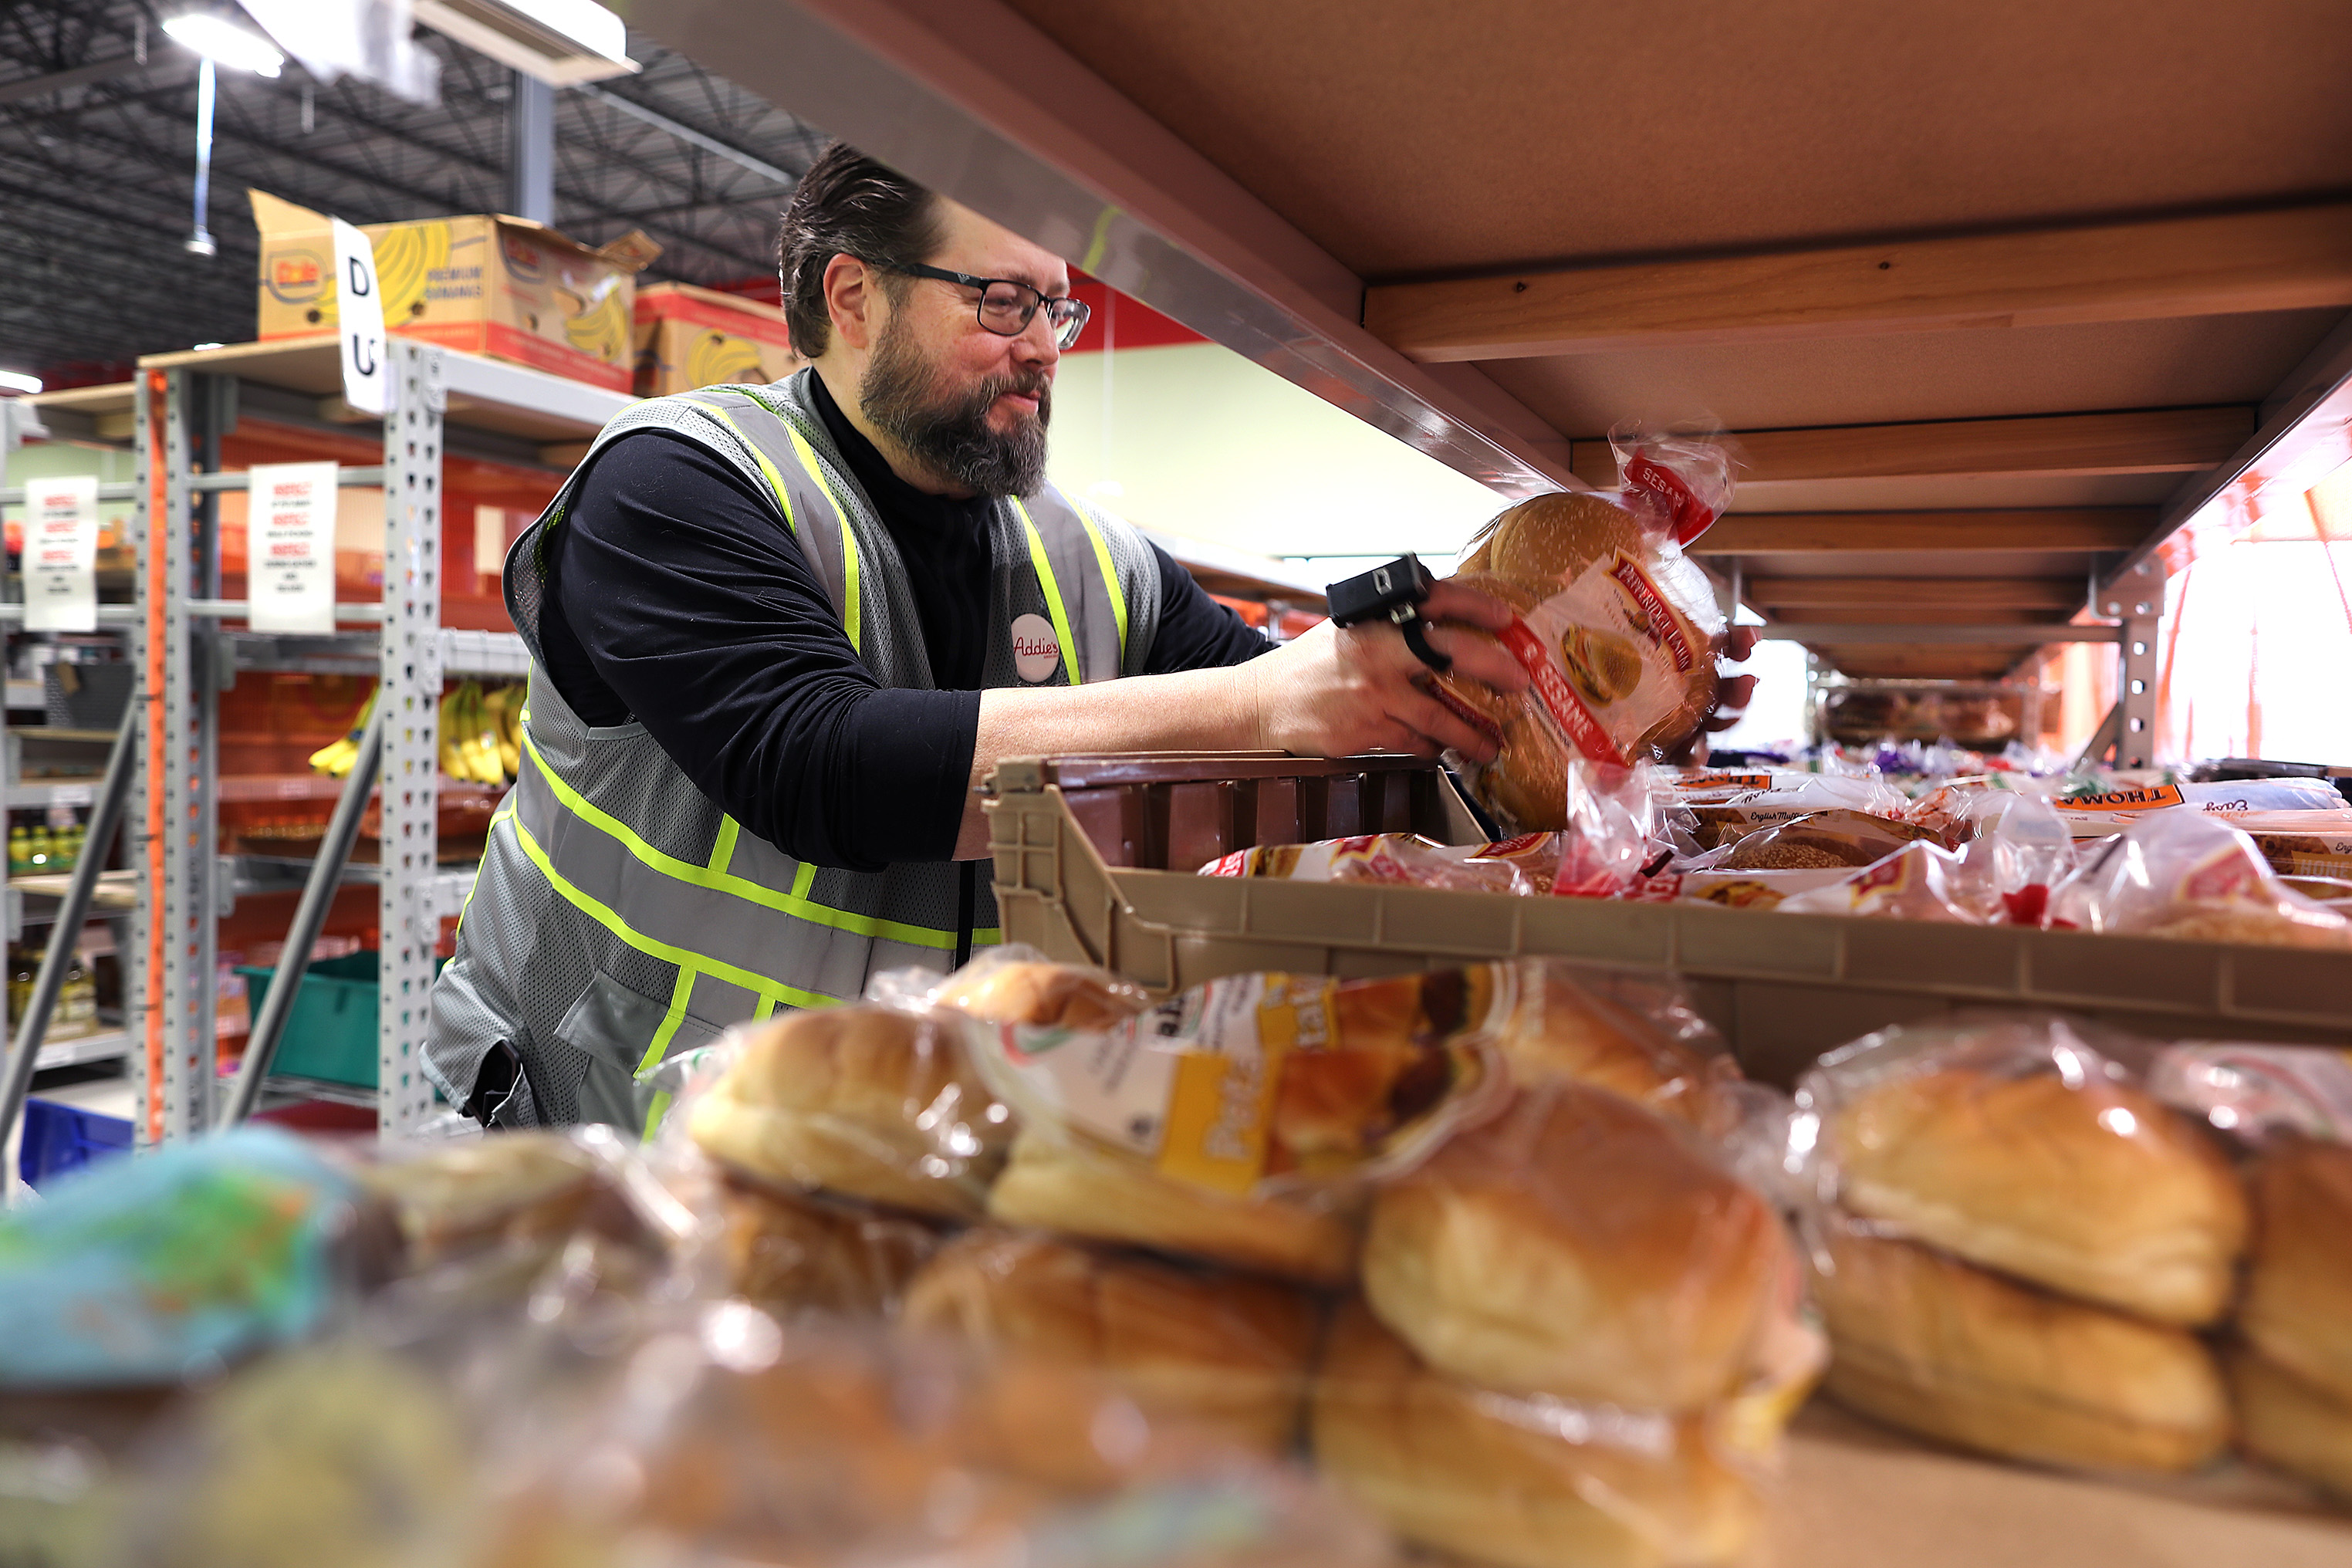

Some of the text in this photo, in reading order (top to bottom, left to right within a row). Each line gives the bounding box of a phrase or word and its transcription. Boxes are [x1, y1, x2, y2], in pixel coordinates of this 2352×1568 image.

[349, 255, 376, 376] D U
[1013, 637, 1058, 656] Addie's
[1537, 663, 1593, 743] SESAME
[2060, 789, 2169, 806] THOMA
[1750, 812, 1801, 823] English Muff
[2335, 842, 2352, 854] Eng
[2300, 859, 2349, 878] HONE
